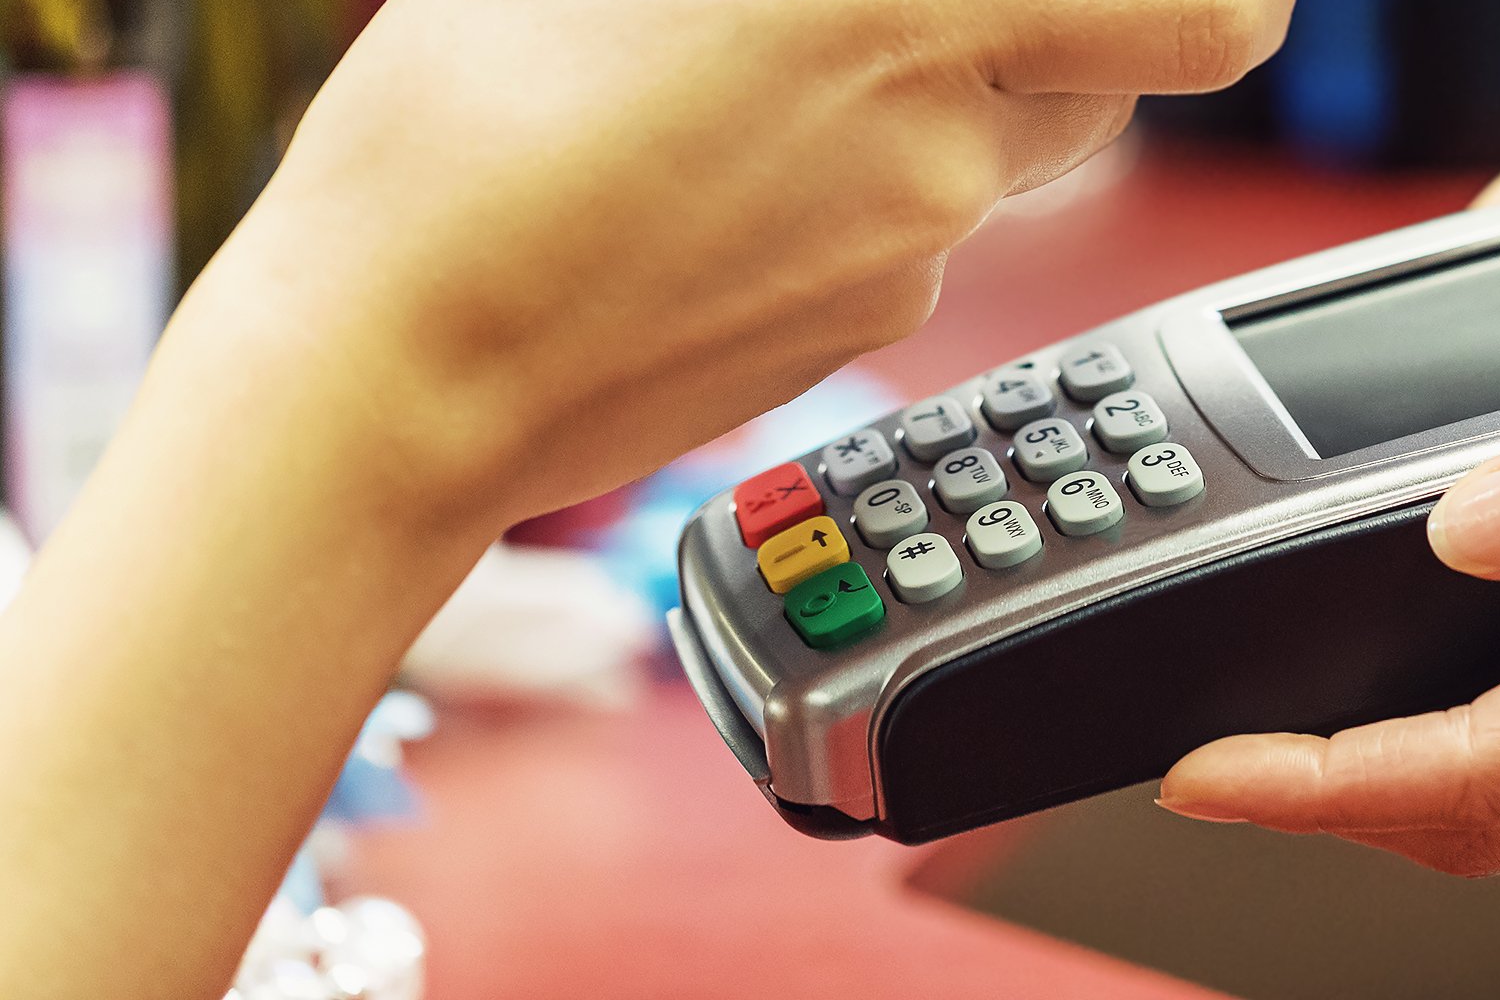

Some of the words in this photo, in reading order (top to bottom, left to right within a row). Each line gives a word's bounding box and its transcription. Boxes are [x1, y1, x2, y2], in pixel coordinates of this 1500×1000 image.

[1073, 352, 1102, 367] 1
[996, 380, 1026, 394] 4
[911, 405, 945, 422] 7
[1105, 400, 1140, 417] 2
[1131, 410, 1153, 427] ABC
[1025, 426, 1061, 443] 5
[1050, 438, 1071, 454] JKL
[945, 455, 978, 474] 8
[970, 464, 991, 484] TUV
[1141, 450, 1176, 467] 3
[1166, 460, 1190, 477] DEF
[868, 488, 900, 507] 0
[1060, 478, 1096, 495] 6
[1085, 488, 1110, 509] MNO
[978, 507, 1012, 526] 9
[1003, 517, 1026, 539] WXY
